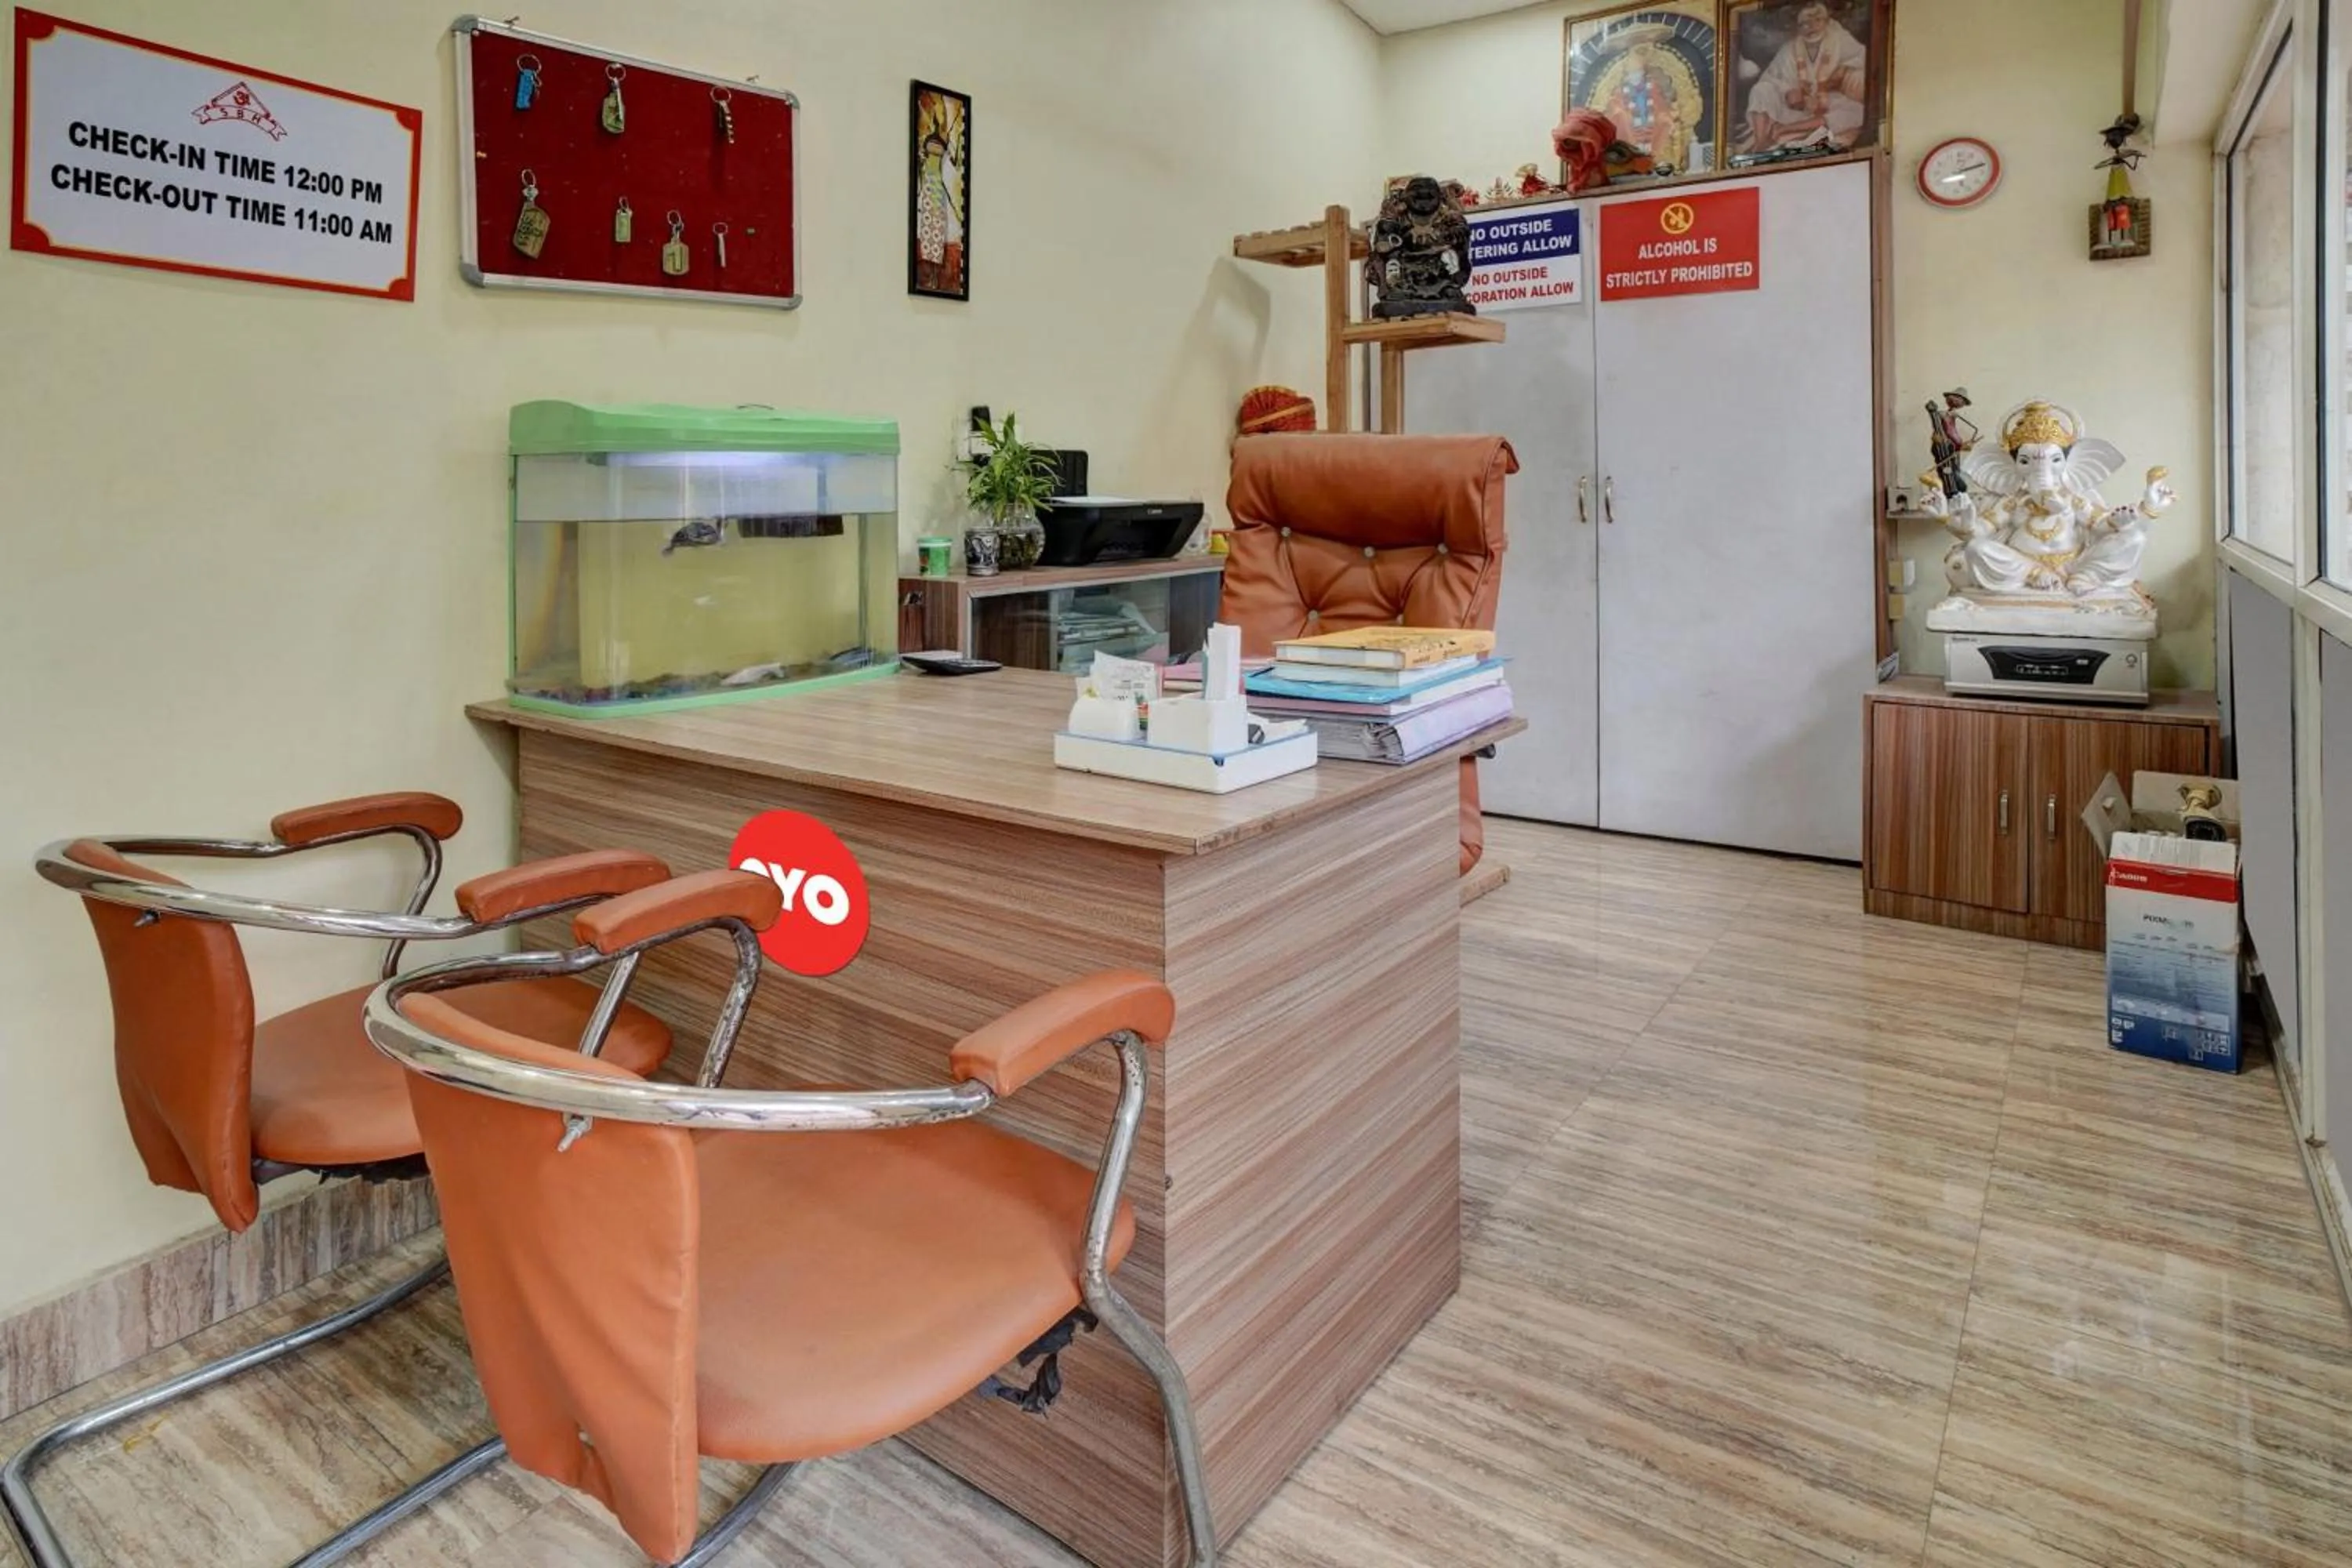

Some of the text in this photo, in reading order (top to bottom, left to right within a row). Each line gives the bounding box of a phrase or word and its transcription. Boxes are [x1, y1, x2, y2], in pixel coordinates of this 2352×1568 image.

[68, 121, 382, 204] CHECK-IN TIME 12:00 PM
[50, 163, 392, 243] CHECK-OUT TIME 11:00 AM
[1490, 219, 1552, 239] OUTSIDE
[1468, 234, 1572, 260] TERING ALLOW
[1638, 238, 1717, 260] ALCOHOL IS
[1472, 267, 1548, 286] NO OUTSIDE
[1530, 281, 1574, 295] ALLOW
[1606, 261, 1752, 289] STRICTLY PROHIBITED
[739, 857, 850, 926] YO
